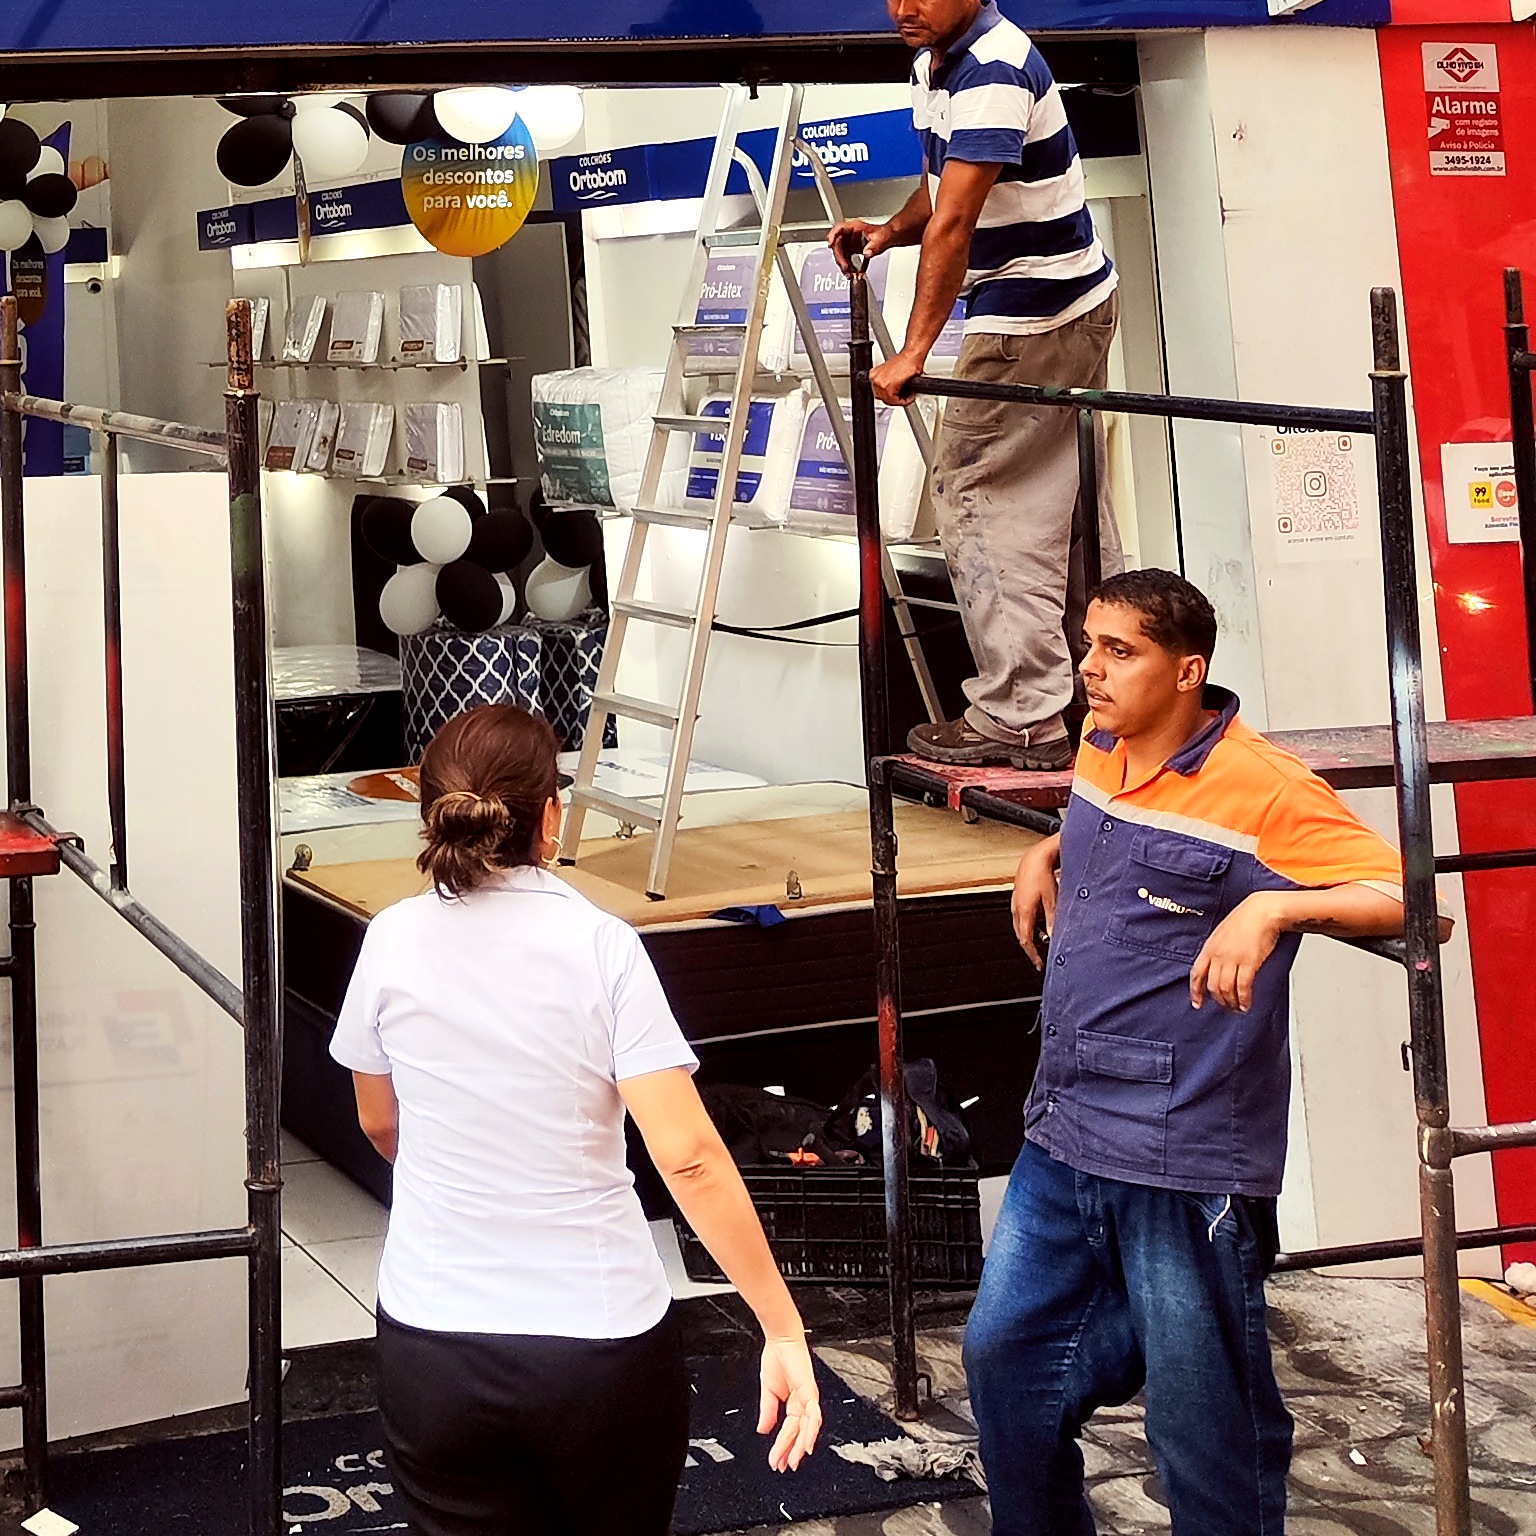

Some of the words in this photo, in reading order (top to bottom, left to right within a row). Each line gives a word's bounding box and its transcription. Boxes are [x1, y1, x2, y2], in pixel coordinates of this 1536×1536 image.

[1432, 95, 1497, 115] Alarme
[803, 122, 848, 139] COLCHÕES
[1472, 118, 1498, 128] registro
[1456, 127, 1466, 136] de
[1467, 128, 1499, 138] imagens
[413, 145, 436, 161] Os
[441, 144, 525, 161] melhores
[1440, 141, 1462, 149] Aviso
[1463, 140, 1468, 149] à
[1444, 156, 1492, 165] 3495-1924
[422, 168, 515, 185] descontos
[569, 168, 627, 192] Ortobom
[423, 194, 461, 212] para
[466, 190, 513, 209] você.
[315, 202, 353, 221] Ortobom
[700, 281, 743, 299] Pró-Látex
[542, 423, 581, 444] Edredom
[1474, 486, 1487, 497] 99
